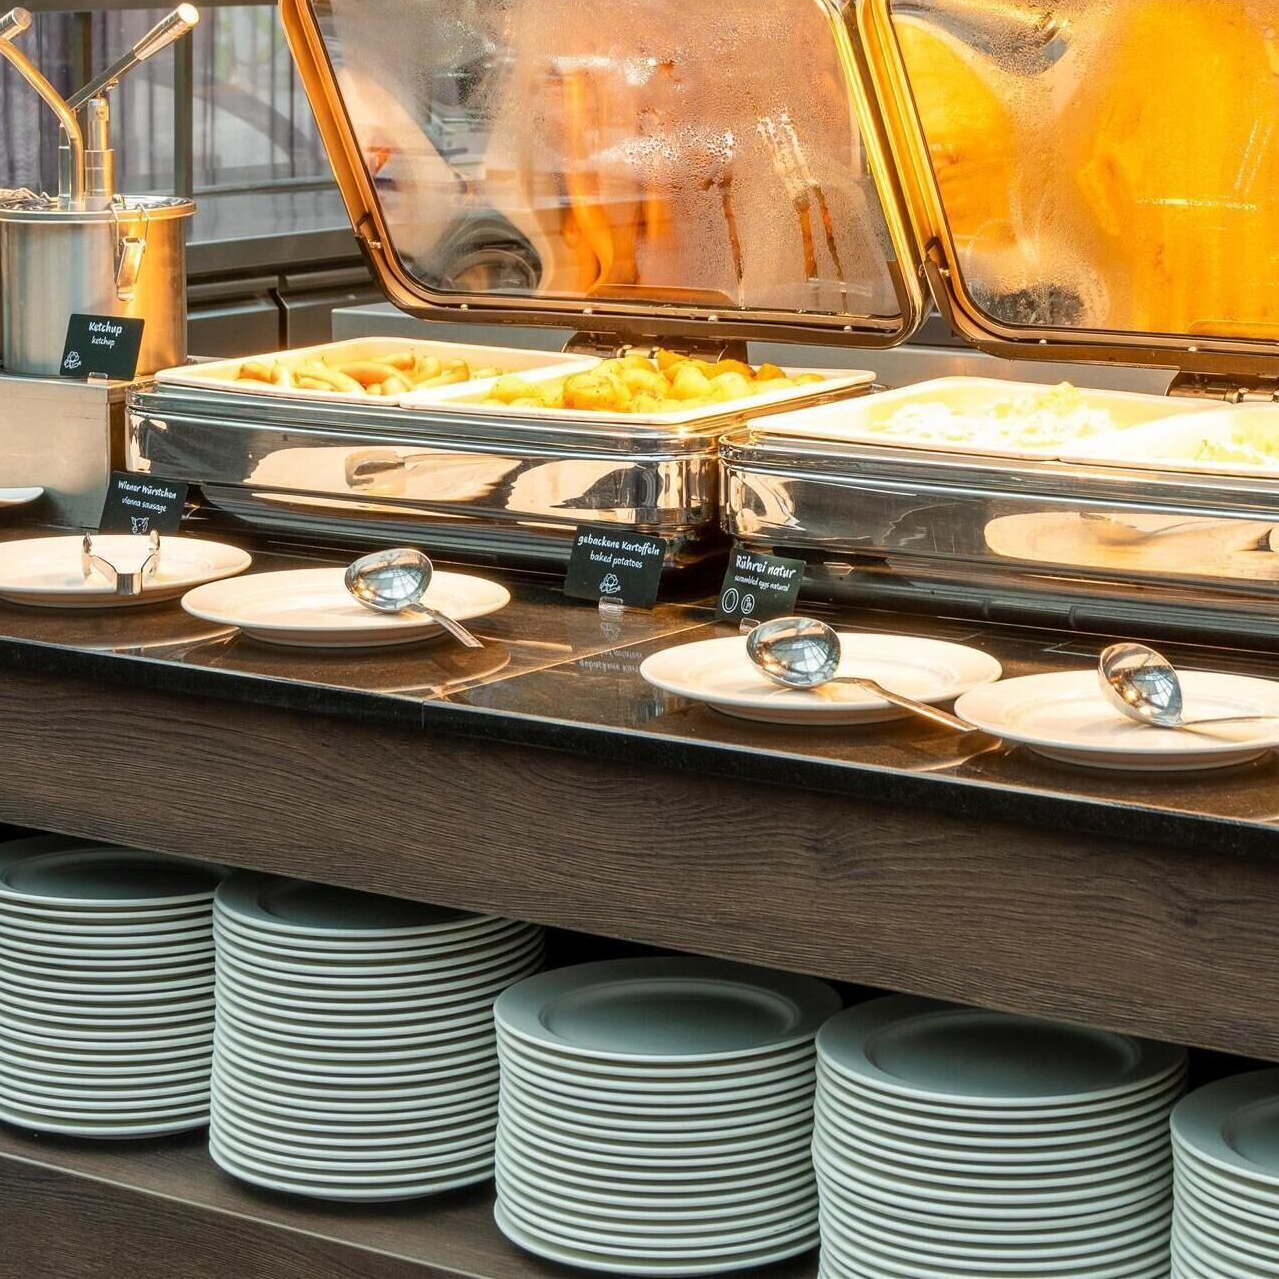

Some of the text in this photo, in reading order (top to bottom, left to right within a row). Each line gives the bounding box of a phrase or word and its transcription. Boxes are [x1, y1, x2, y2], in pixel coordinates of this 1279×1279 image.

[88, 320, 123, 337] Ketchup
[91, 335, 115, 349] ketchup
[118, 480, 177, 499] Wiener Würstchen
[122, 496, 167, 514] vienna sausage
[577, 533, 660, 556] gebackene Kartoffeln
[589, 550, 643, 569] baked potatoes
[736, 555, 797, 579] Rührei natur
